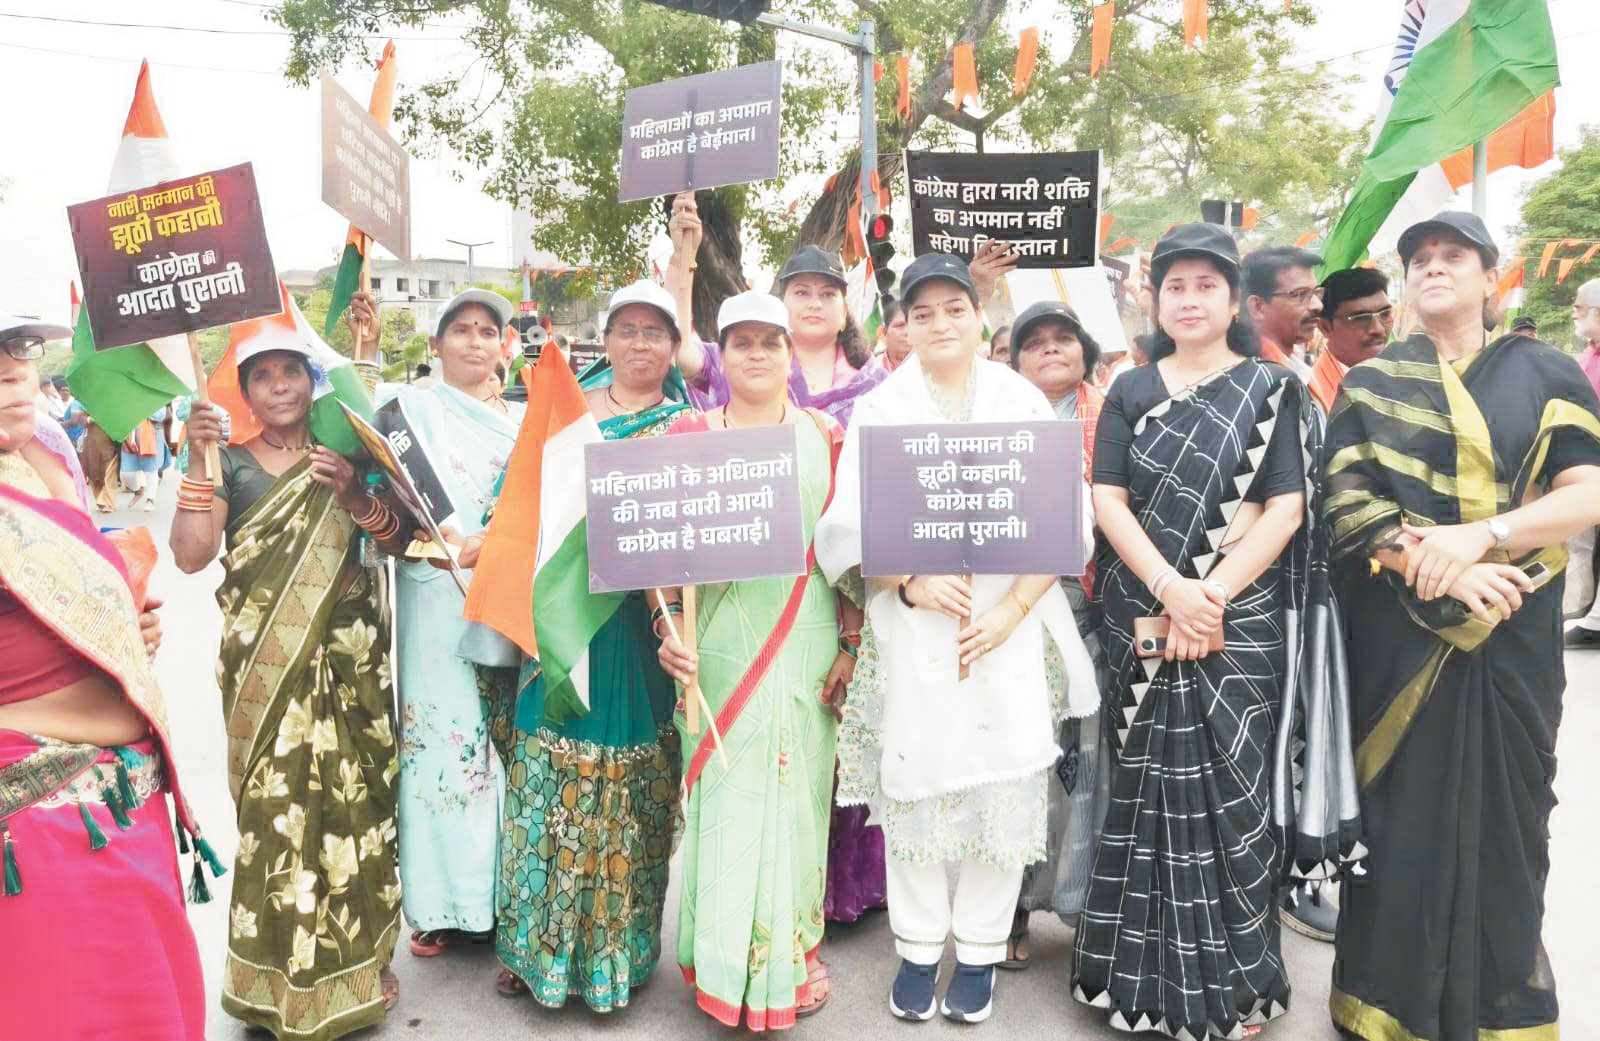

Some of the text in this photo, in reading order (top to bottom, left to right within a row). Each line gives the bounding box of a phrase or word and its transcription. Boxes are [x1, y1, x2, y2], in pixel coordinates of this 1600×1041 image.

[629, 100, 773, 139] महिलाओं का अपमान
[640, 126, 756, 160] कांग्रेस है बेईमान।
[107, 176, 215, 218] नारी सम्मान की
[913, 176, 1091, 204] कांग्रेस द्वारा नारी शक्ति
[110, 196, 224, 255] झूठी कहानी
[933, 206, 1066, 230] का अपमान नहीं
[928, 231, 970, 254] सहेगा
[137, 250, 216, 285] कांग्रेस की
[117, 261, 246, 316] आदत पुरानी
[903, 430, 1035, 455] नारी सम्मान की
[590, 453, 793, 496] महिलाओं के अधिकारों
[917, 459, 1027, 490] झूठी कहानी,
[611, 485, 775, 524] की जब बारी आयी
[926, 488, 1014, 512] कांग्रेस की
[617, 517, 770, 554] कांग्रेस है घबराई।
[913, 516, 1027, 546] आदत पुरानी।
